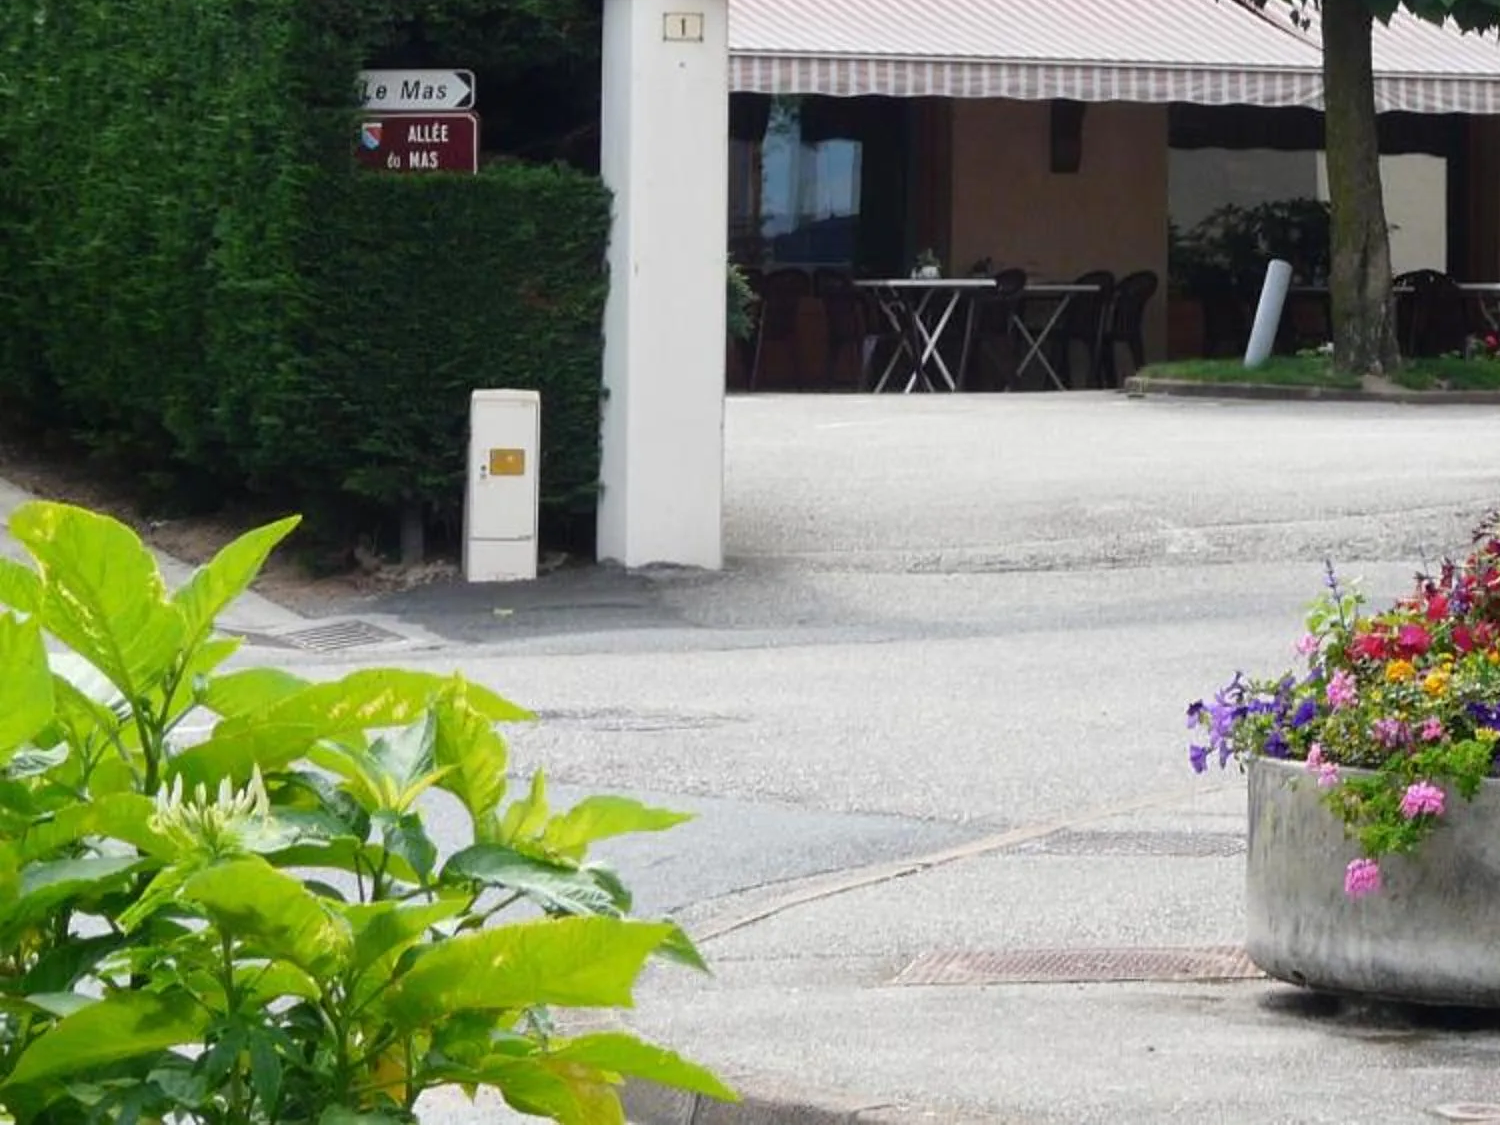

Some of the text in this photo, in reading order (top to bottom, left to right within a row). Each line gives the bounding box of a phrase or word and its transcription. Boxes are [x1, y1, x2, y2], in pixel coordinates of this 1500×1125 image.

[362, 80, 448, 101] Le Mas
[407, 122, 449, 143] ALLÉE
[409, 151, 439, 168] MAS
